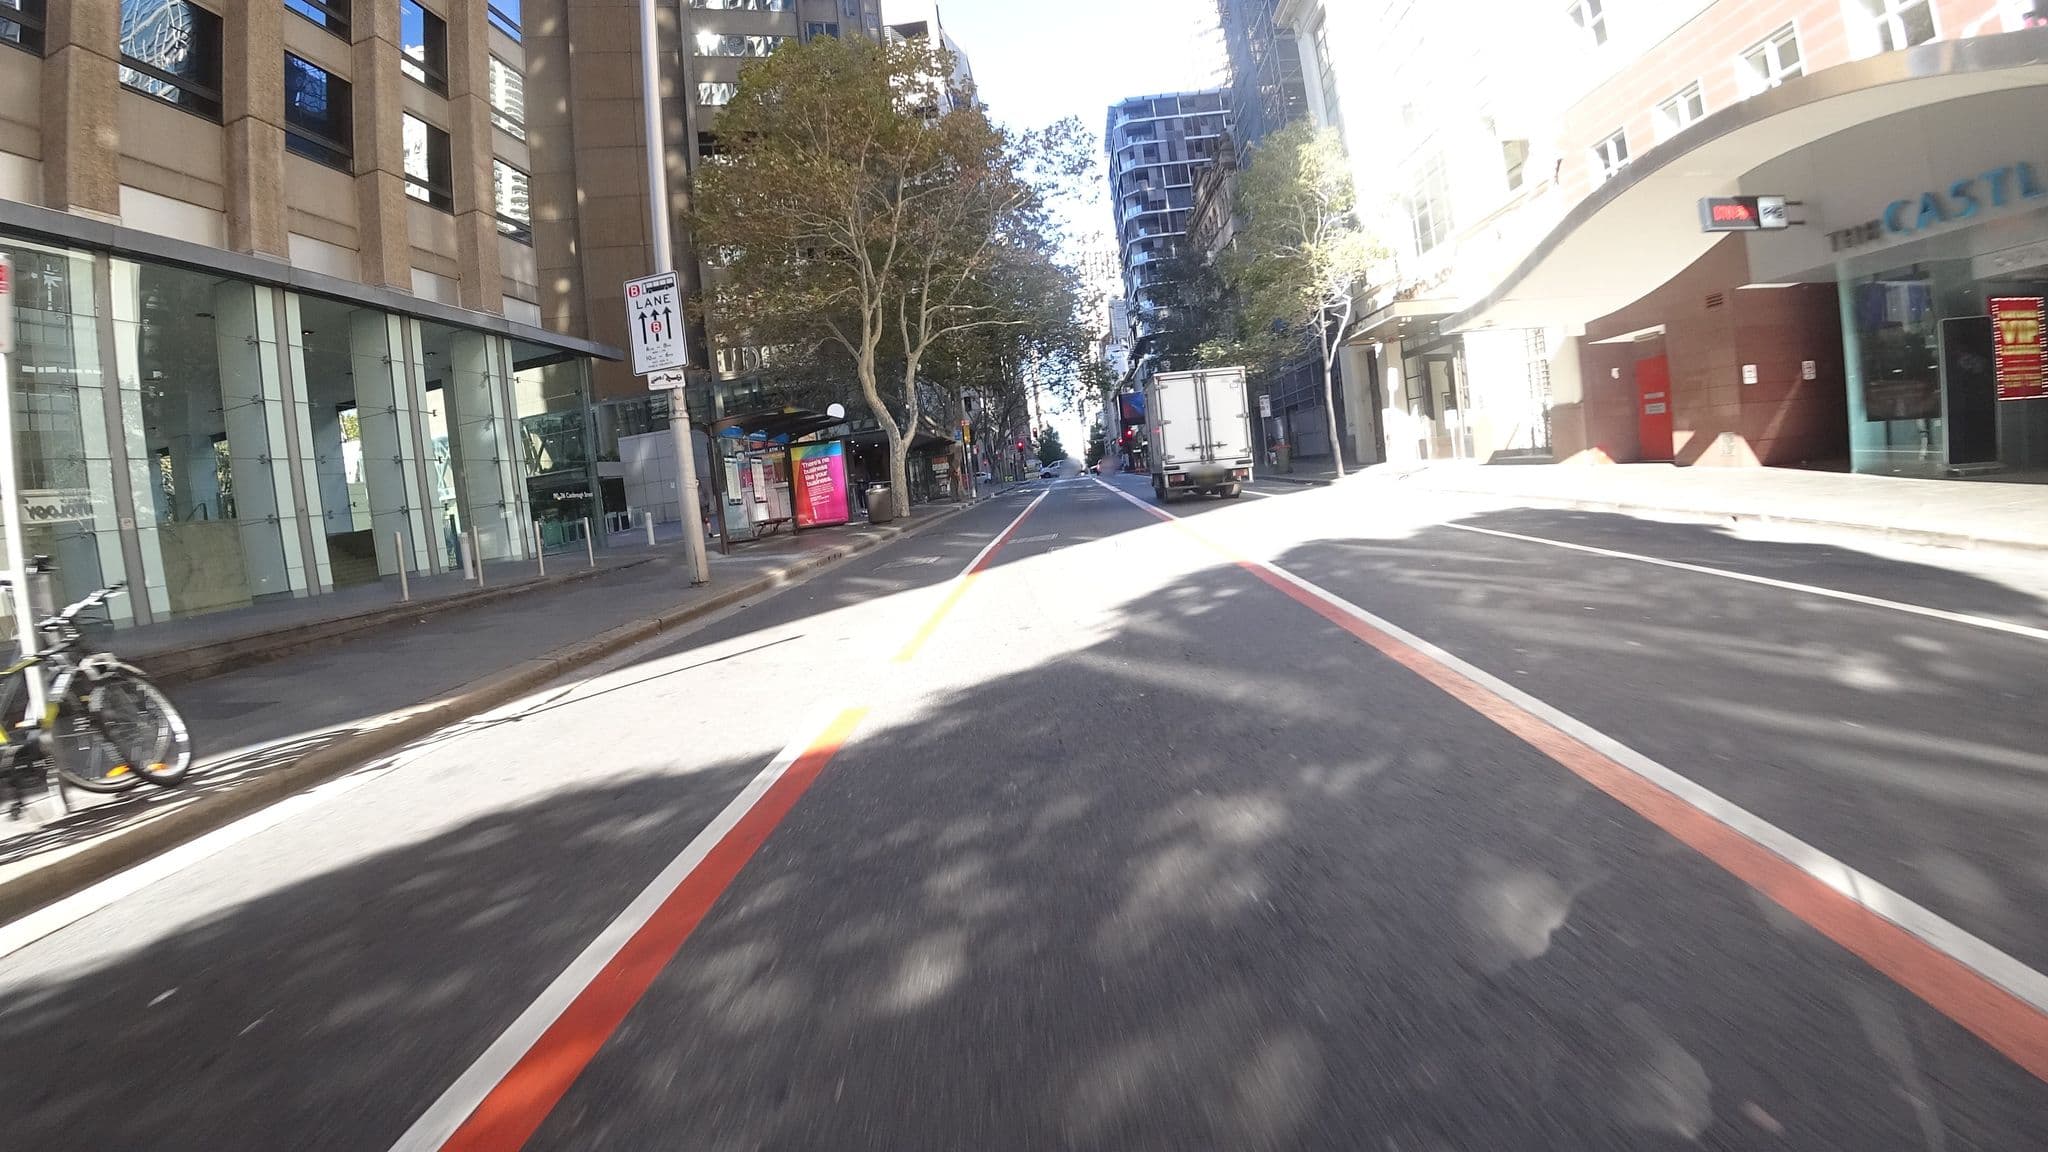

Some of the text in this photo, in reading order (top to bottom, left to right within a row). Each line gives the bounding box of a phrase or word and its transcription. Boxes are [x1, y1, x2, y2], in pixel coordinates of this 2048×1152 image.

[630, 285, 639, 297] B
[635, 293, 671, 310] LANE
[652, 322, 661, 332] B
[1999, 319, 2040, 344] VIP
